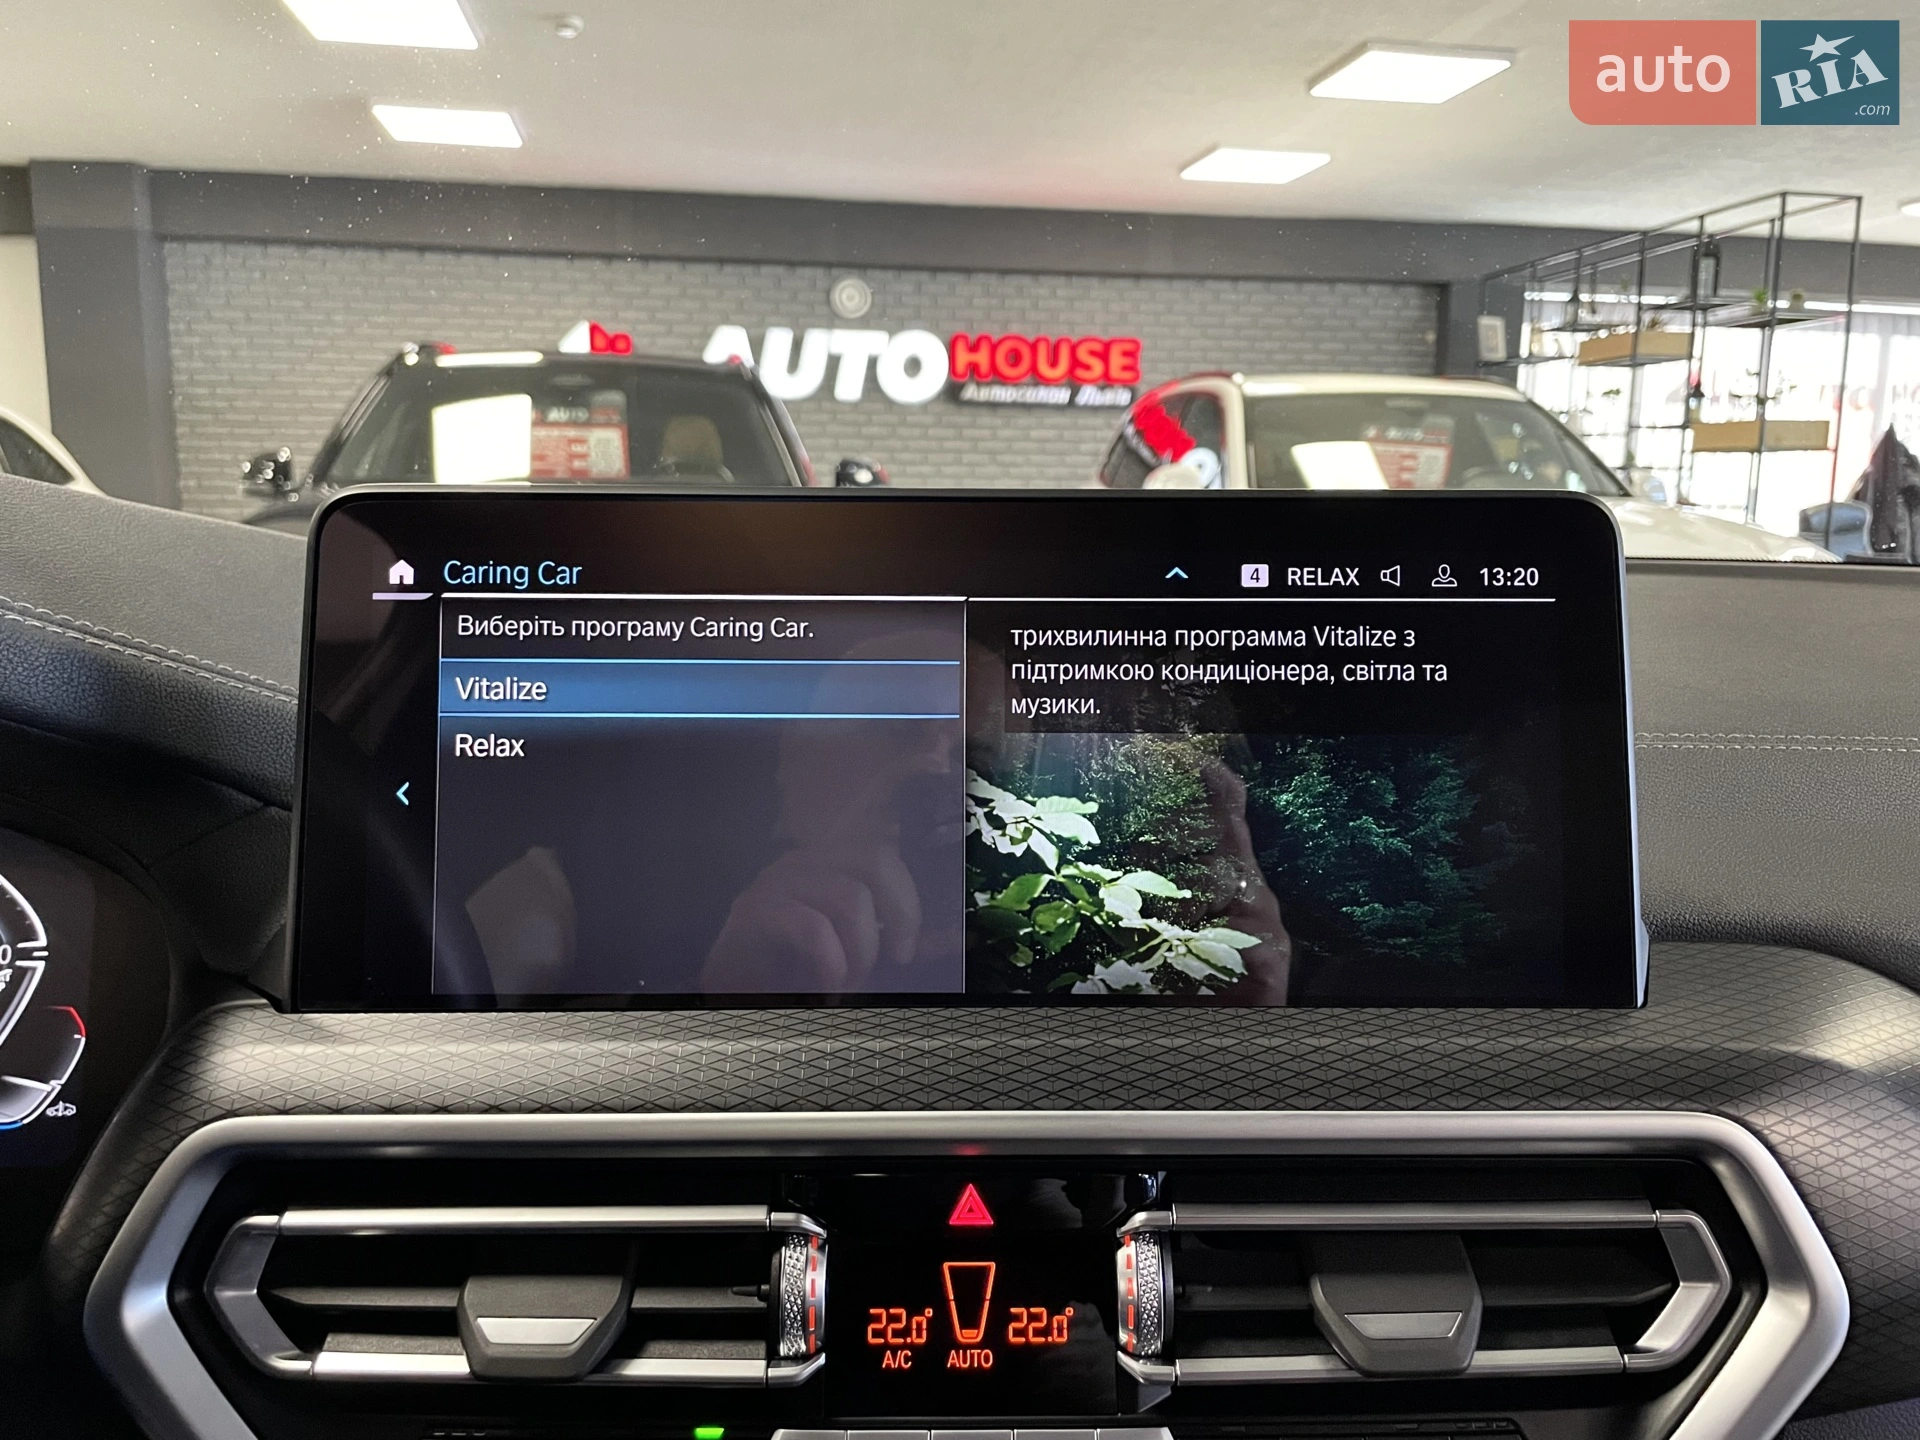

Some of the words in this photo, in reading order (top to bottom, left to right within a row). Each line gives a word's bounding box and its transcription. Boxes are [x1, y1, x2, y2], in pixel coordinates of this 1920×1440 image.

[702, 324, 950, 403] AUTO
[951, 332, 1142, 386] HOUSE
[443, 560, 529, 590] Caring
[537, 560, 582, 586] Car
[1287, 567, 1360, 586] RELAX
[1479, 567, 1539, 587] 13:20
[457, 615, 565, 638] Виберіть
[571, 620, 685, 642] програму
[690, 616, 764, 643] Caring
[770, 617, 815, 638] Car.
[1010, 628, 1167, 648] трихвилинна
[1175, 629, 1306, 649] программа
[1313, 625, 1397, 648] Vitalize
[1011, 658, 1154, 685] підтримкою
[1161, 659, 1335, 685] кондиціонера,
[1342, 660, 1415, 682] світла
[1422, 664, 1448, 682] та
[455, 677, 547, 702] Vitalize
[1011, 697, 1101, 718] музики.
[455, 733, 525, 758] Relax
[882, 1350, 912, 1368] A/C
[947, 1349, 993, 1368] AUTO
